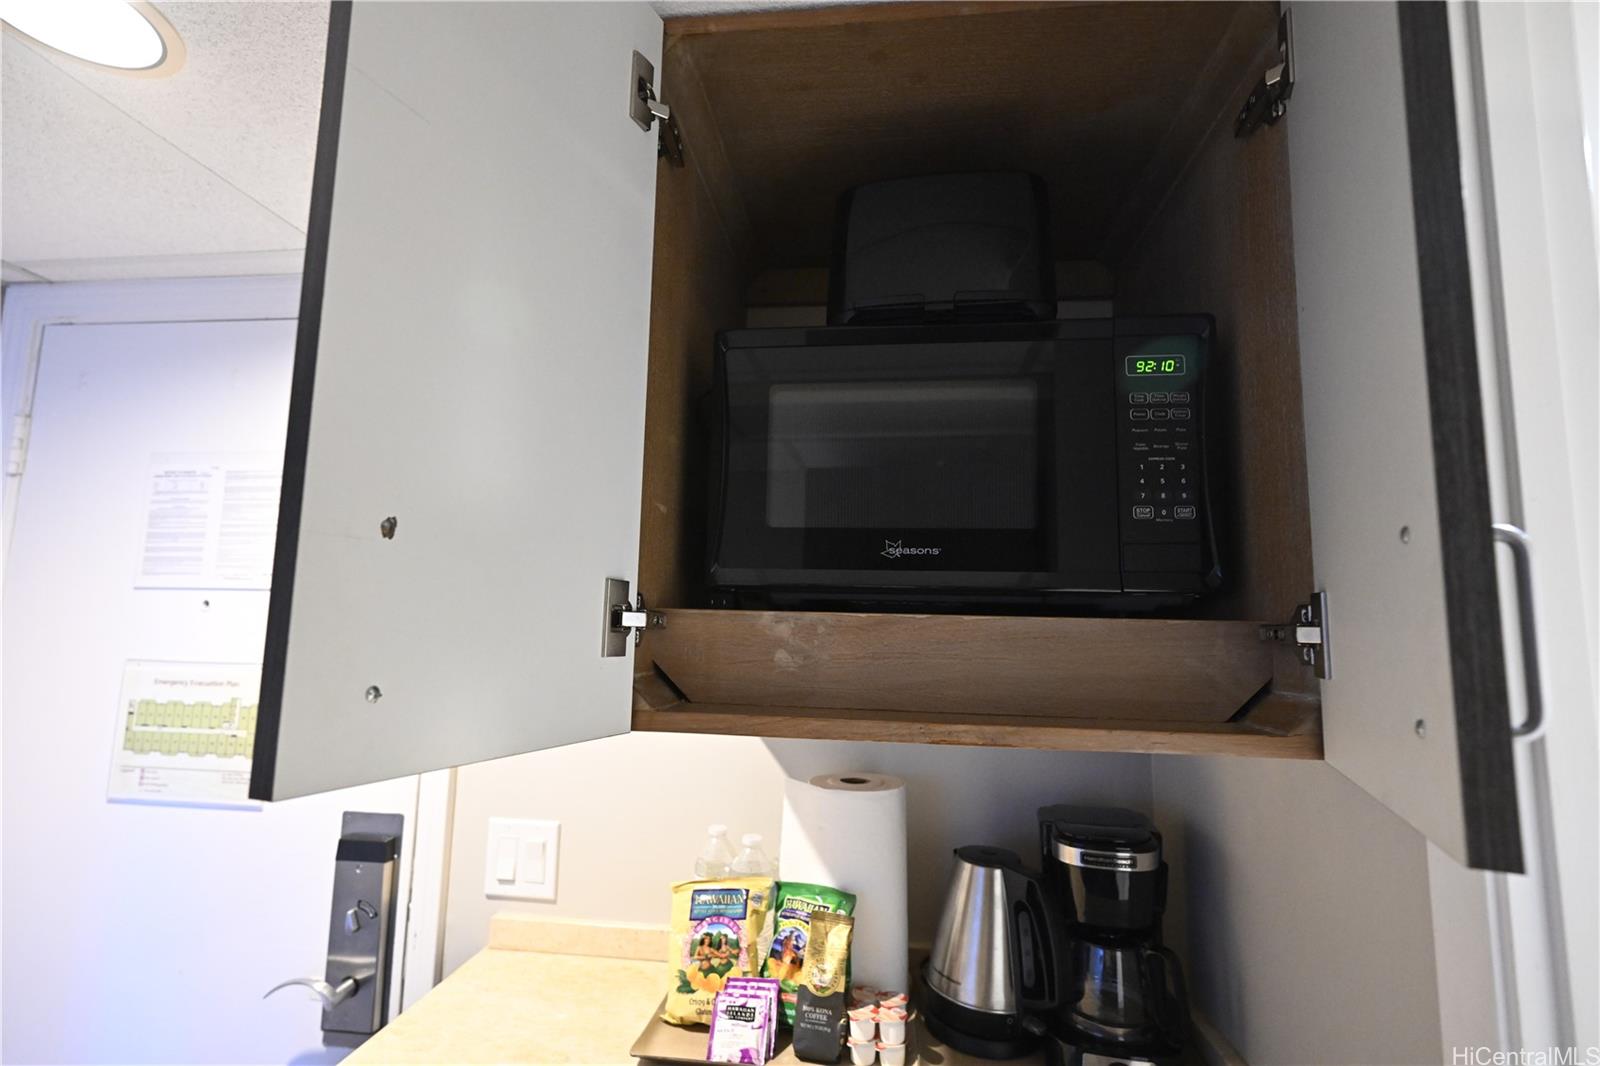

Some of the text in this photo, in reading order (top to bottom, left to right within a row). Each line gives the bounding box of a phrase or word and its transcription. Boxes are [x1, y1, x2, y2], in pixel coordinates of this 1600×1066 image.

[1136, 360, 1175, 372] 92:10
[888, 547, 940, 555] seasons
[694, 894, 744, 904] HAWAIIAN
[815, 1007, 832, 1015] KONA
[804, 1012, 829, 1021] COFFEE
